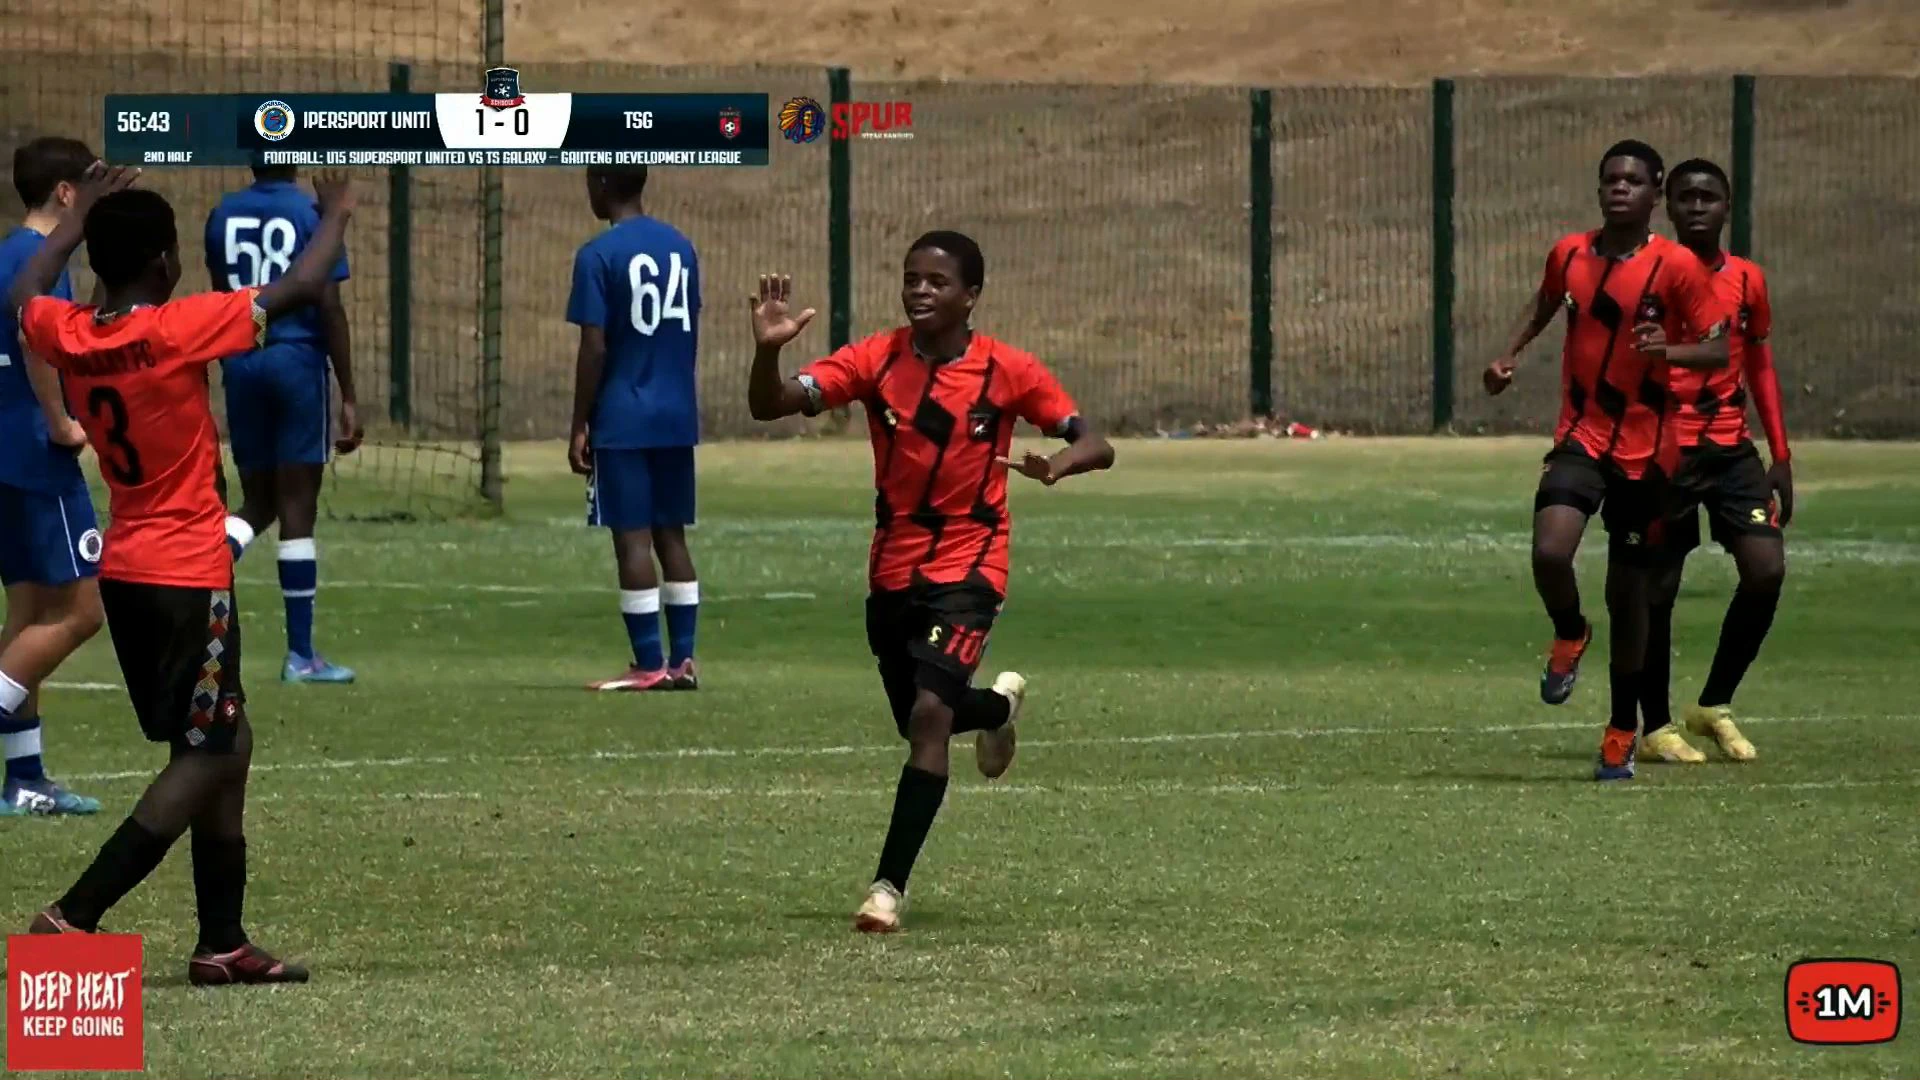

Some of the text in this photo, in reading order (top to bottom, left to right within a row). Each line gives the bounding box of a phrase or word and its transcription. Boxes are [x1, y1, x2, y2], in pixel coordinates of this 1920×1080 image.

[225, 216, 296, 291] 58
[628, 252, 691, 336] 64
[88, 386, 143, 486] 3
[943, 623, 985, 665] 10
